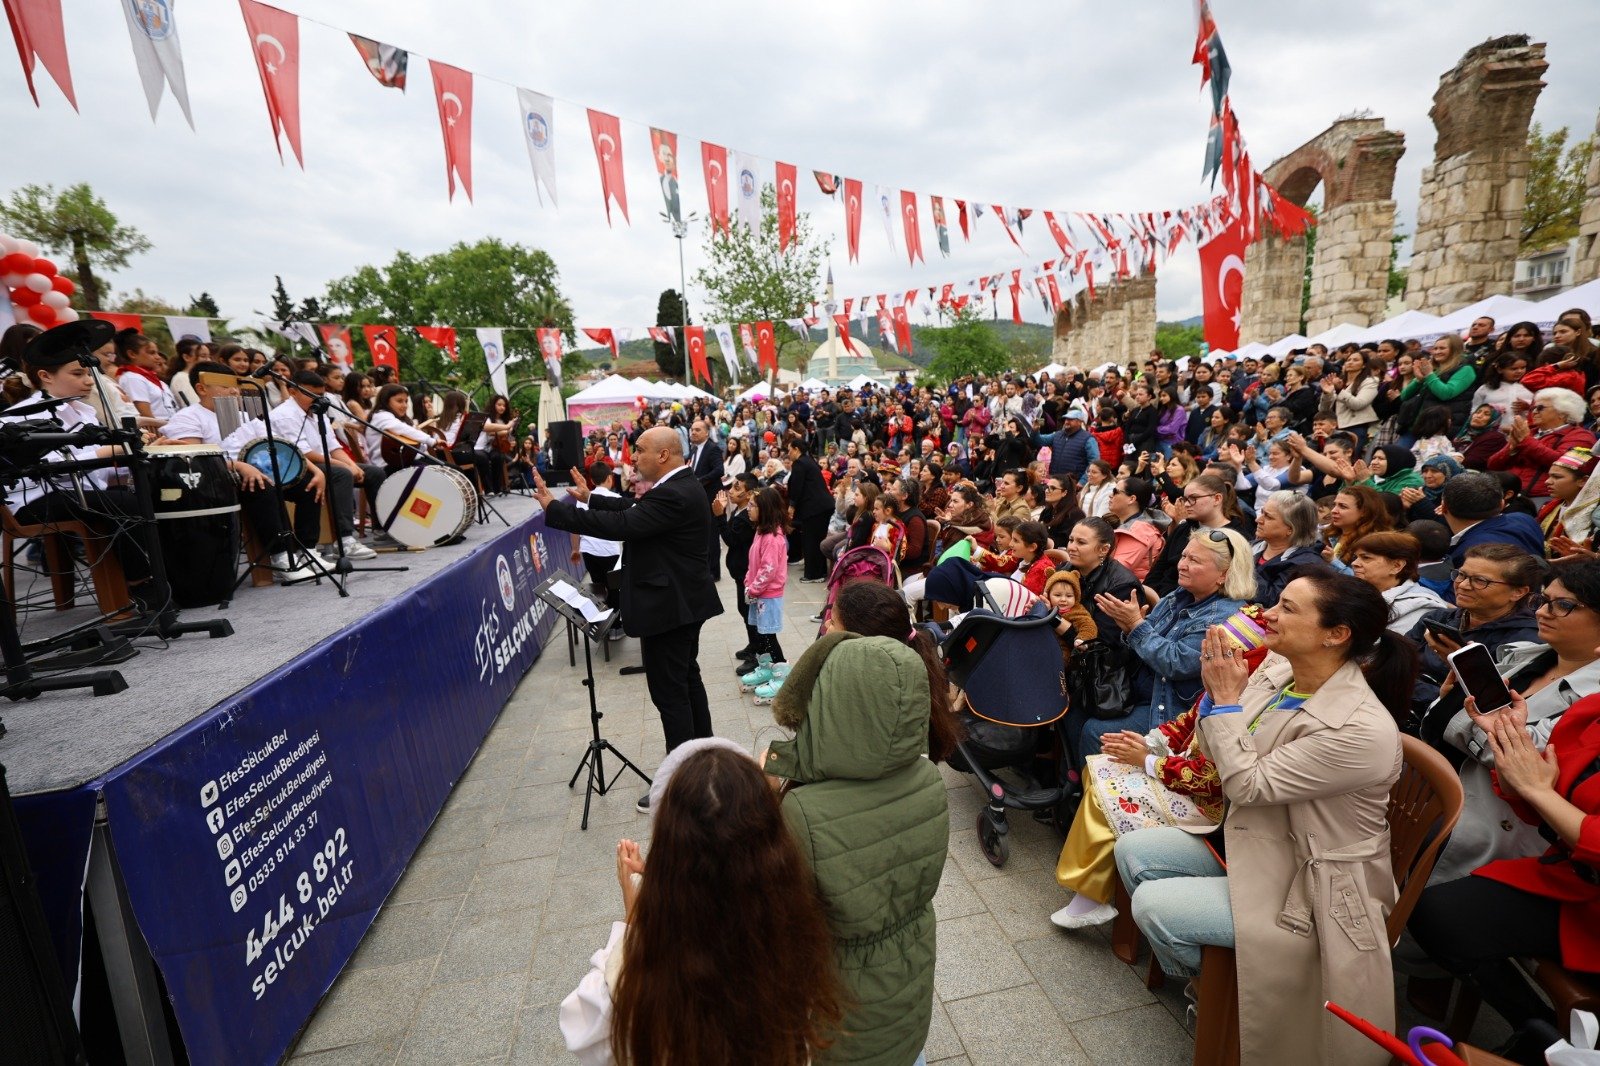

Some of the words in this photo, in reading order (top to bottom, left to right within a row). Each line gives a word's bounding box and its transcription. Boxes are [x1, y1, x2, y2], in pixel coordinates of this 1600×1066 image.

[474, 597, 499, 686] Efes
[494, 611, 533, 674] SELÇUK
[219, 728, 289, 792] EfesSelcukBel
[225, 729, 320, 818] EfesSelcukBelediyesi
[231, 750, 327, 844] EfesSelcukBelediyesi
[240, 771, 333, 868] EfesSelcukBelediyesi
[248, 857, 276, 892] 0533
[276, 837, 296, 863] 814
[295, 823, 307, 843] 33
[306, 810, 319, 830] 37
[246, 893, 295, 967] 444
[296, 871, 313, 904] 8
[312, 827, 349, 883] 892
[252, 859, 354, 1001] selcuk.bel.tr
